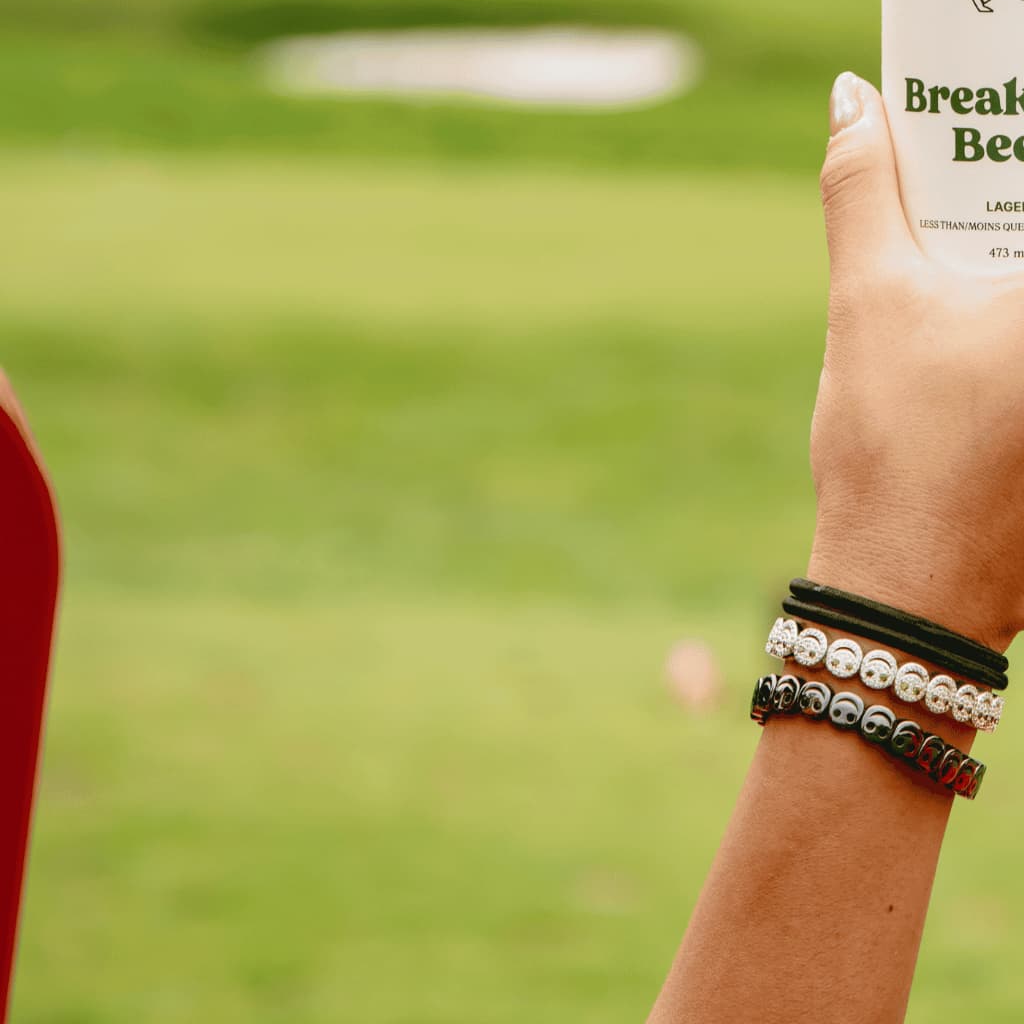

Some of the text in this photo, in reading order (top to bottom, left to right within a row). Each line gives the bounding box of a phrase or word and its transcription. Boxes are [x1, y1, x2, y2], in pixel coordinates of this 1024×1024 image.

[919, 219, 939, 230] LESS
[940, 220, 1001, 232] THAN/MOINS
[1002, 222, 1024, 232] QUE
[988, 247, 1010, 259] 473
